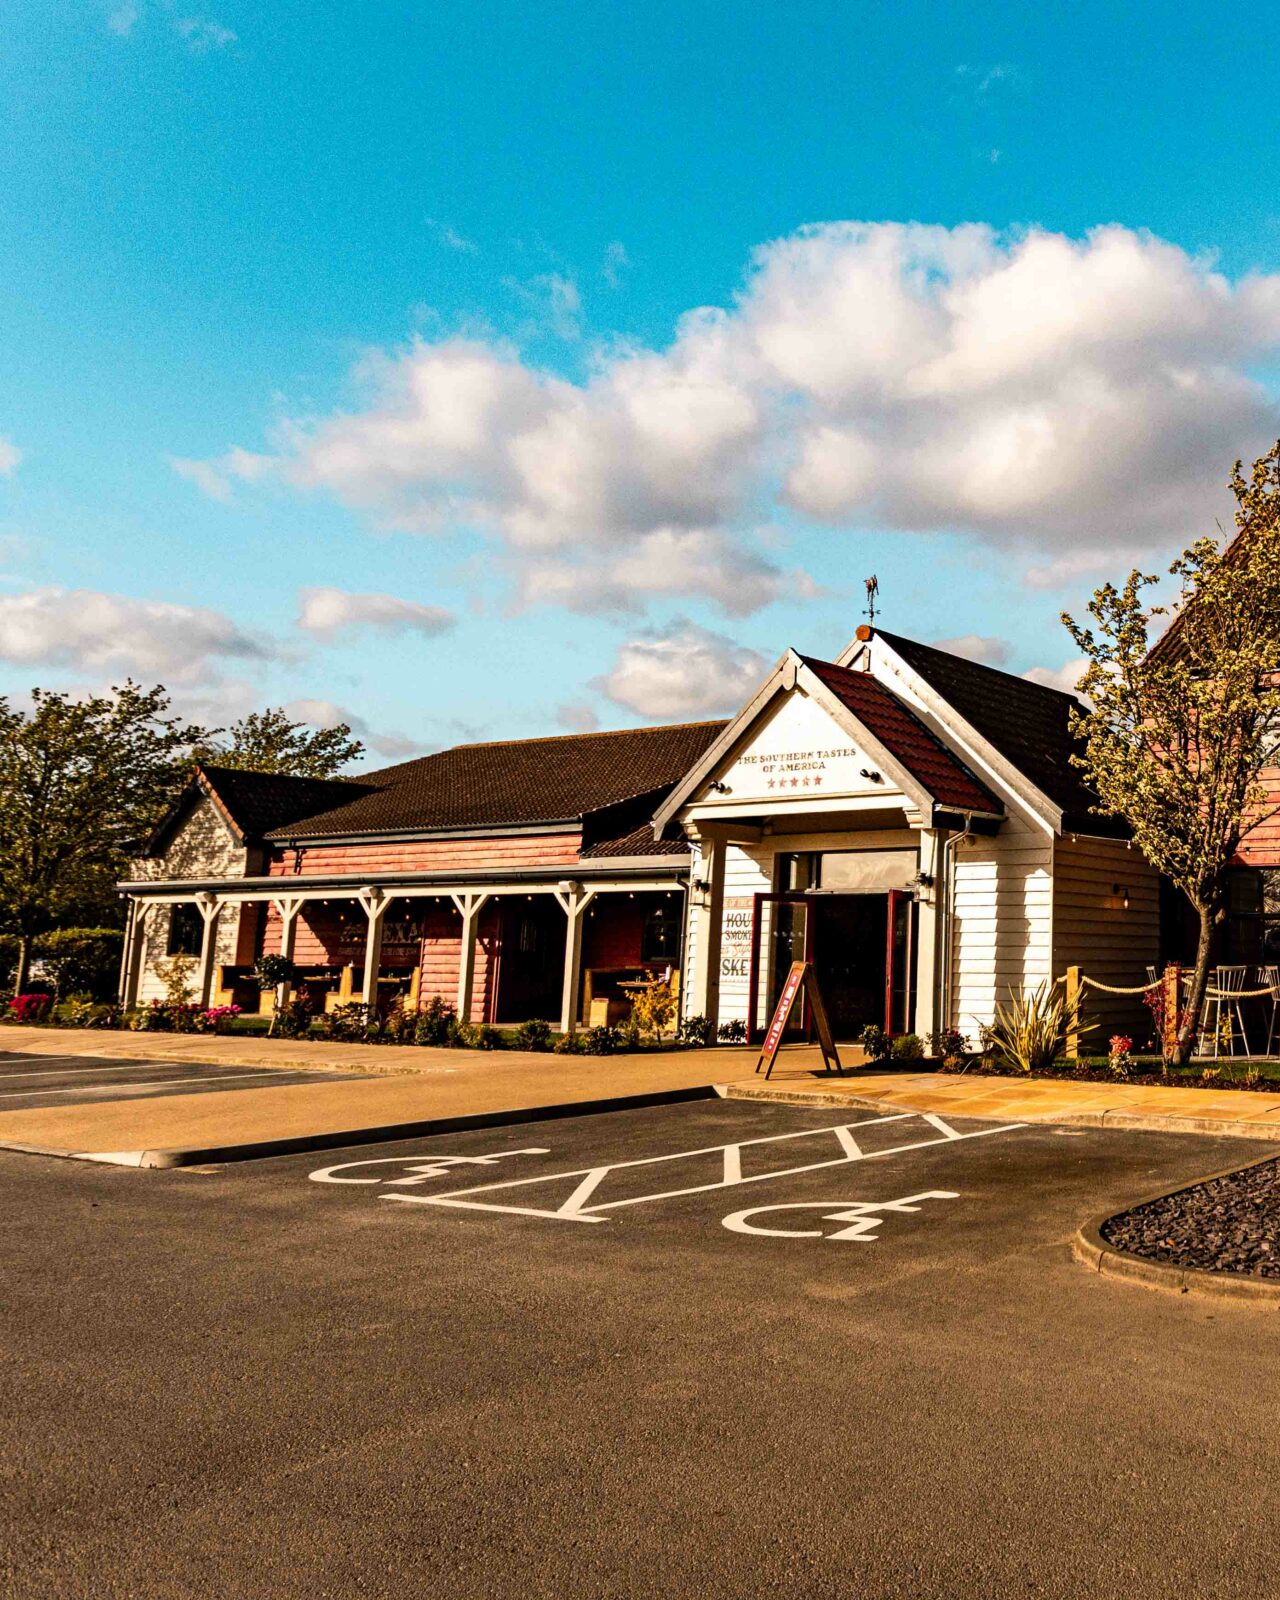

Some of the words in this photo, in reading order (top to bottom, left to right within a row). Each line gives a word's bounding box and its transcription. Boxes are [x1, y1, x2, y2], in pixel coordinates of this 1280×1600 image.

[738, 756, 757, 765] THE
[760, 752, 814, 763] SOUTHERN
[817, 748, 857, 759] TASTES
[762, 765, 776, 773] OF
[779, 761, 826, 773] AMERICA
[726, 912, 754, 928] HOU
